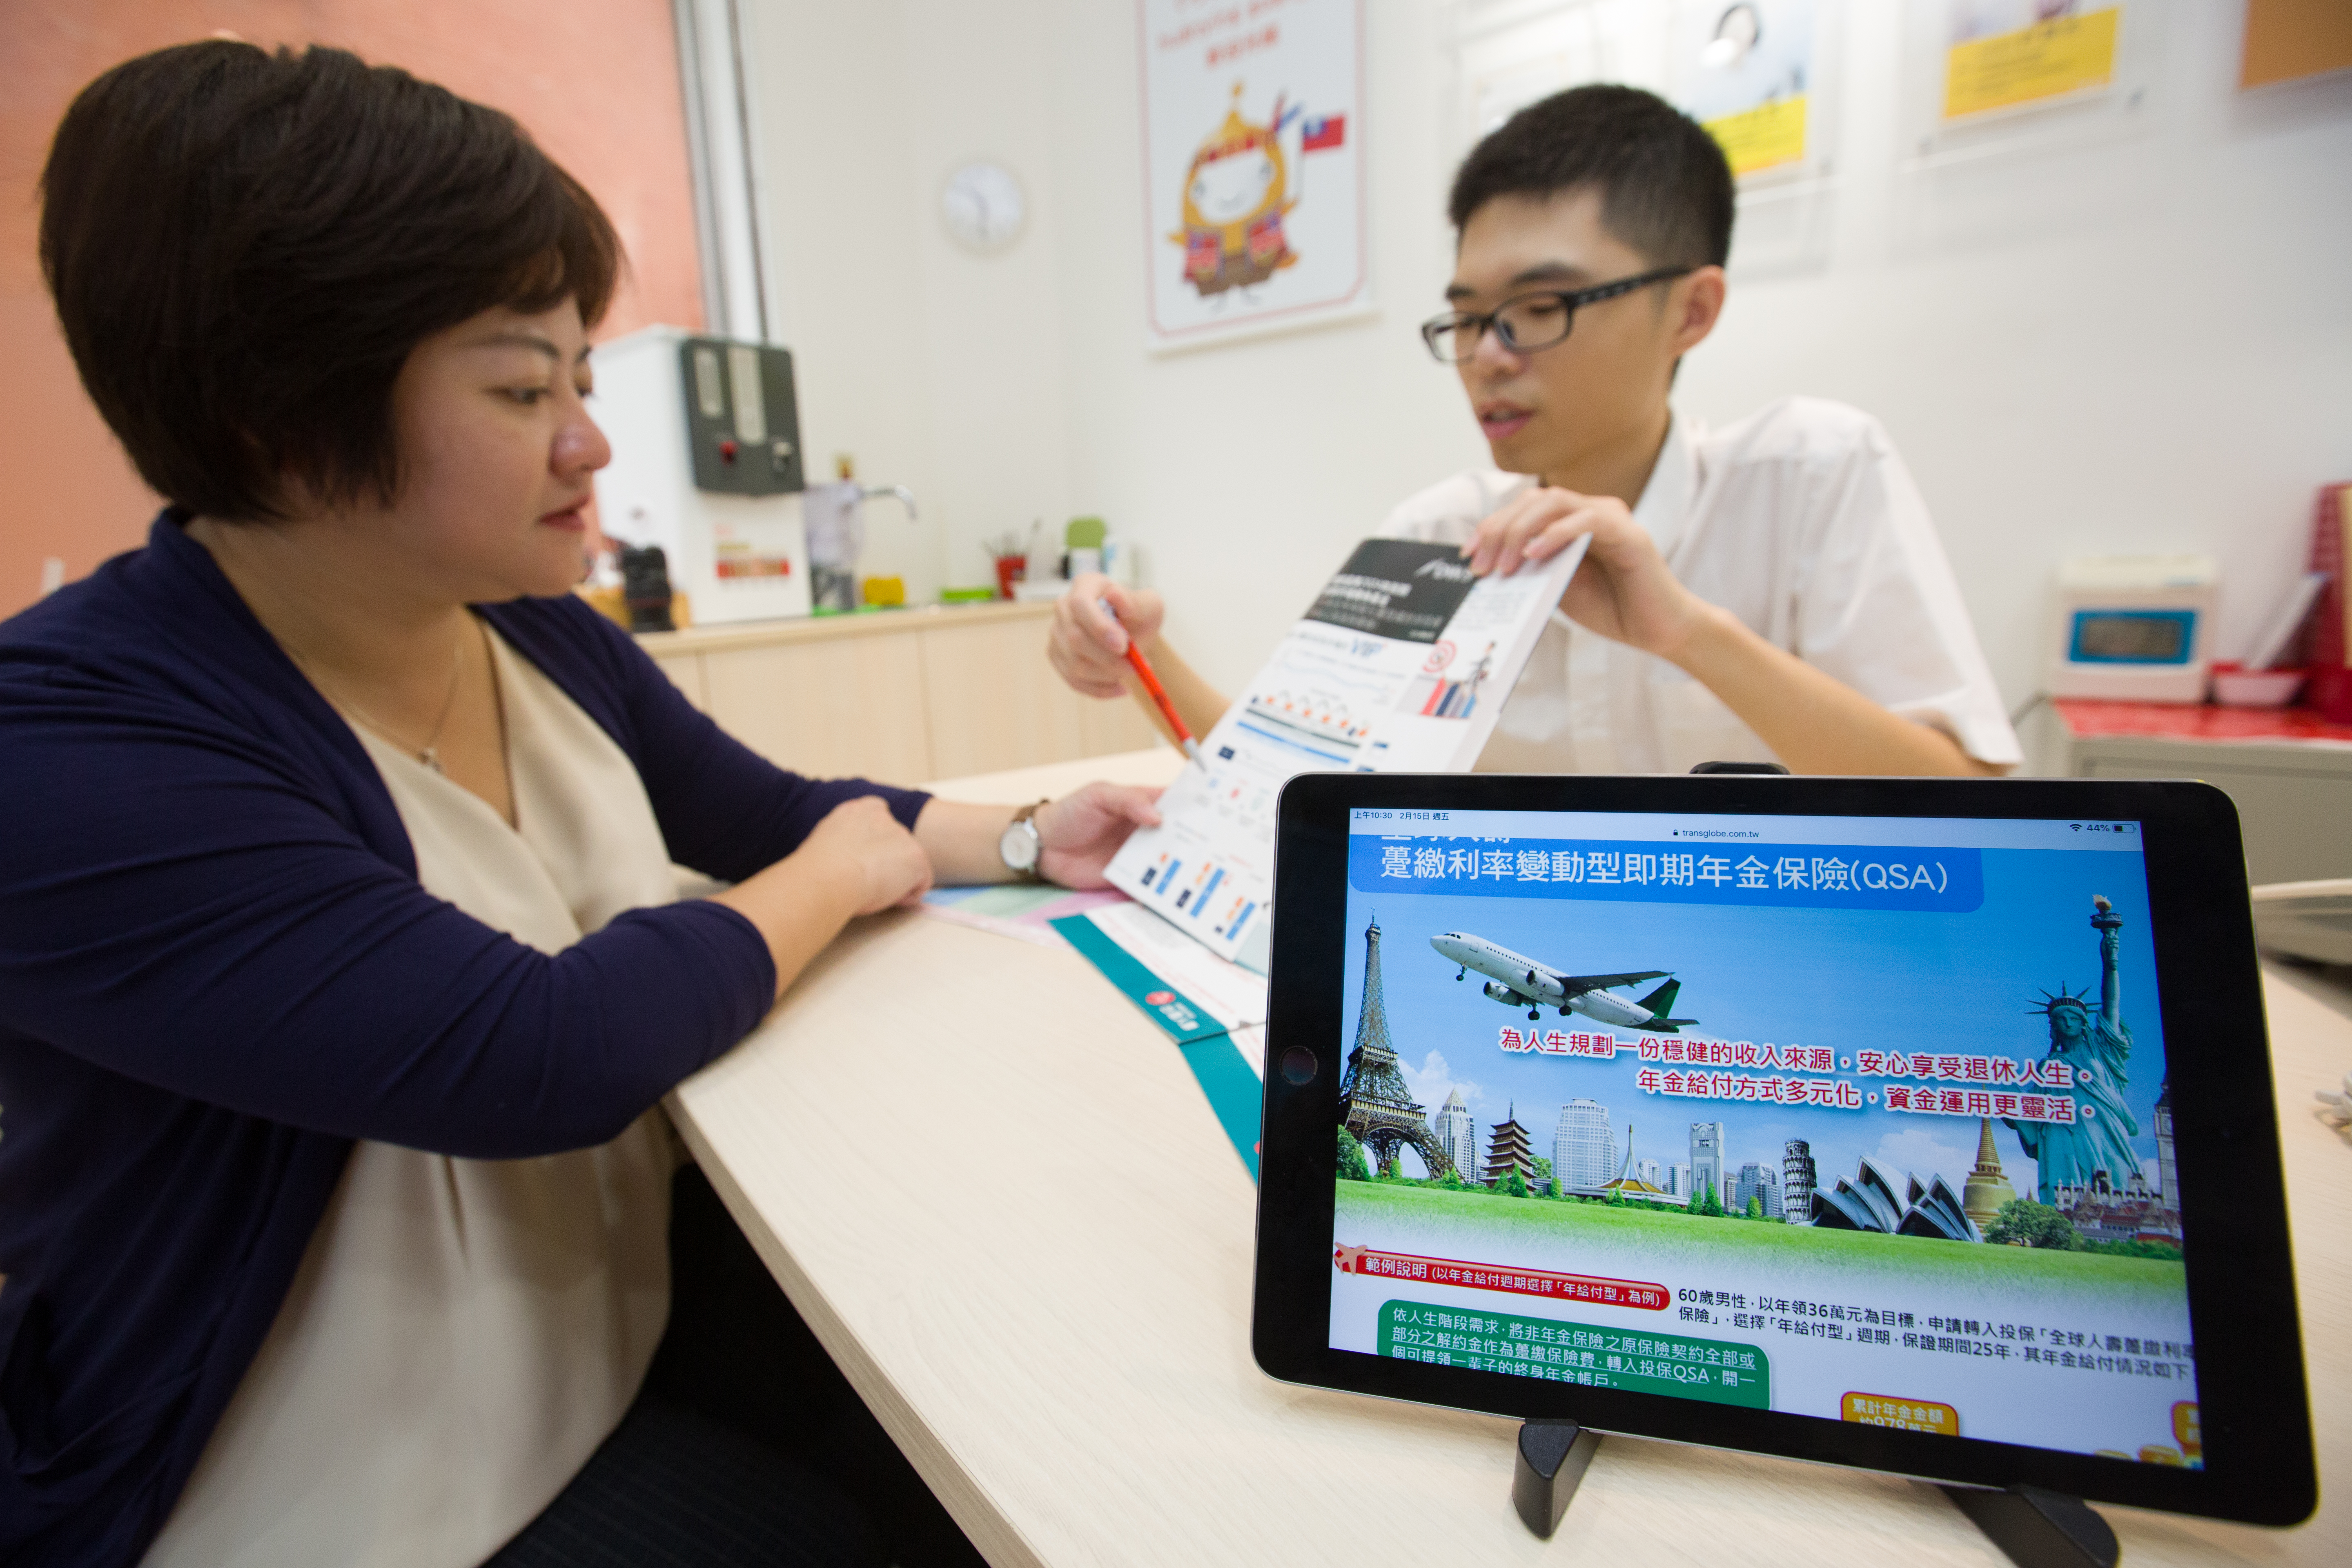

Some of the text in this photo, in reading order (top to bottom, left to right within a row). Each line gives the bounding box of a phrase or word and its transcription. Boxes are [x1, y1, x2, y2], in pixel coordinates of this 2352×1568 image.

[1354, 811, 1449, 821] 上午10:30 2月15日 週五
[1682, 829, 1760, 838] transglobe.com.tw
[1381, 846, 1948, 894] 躉繳利率變動型即期年金保險(QSA)
[1365, 1256, 1427, 1278] 範例說明
